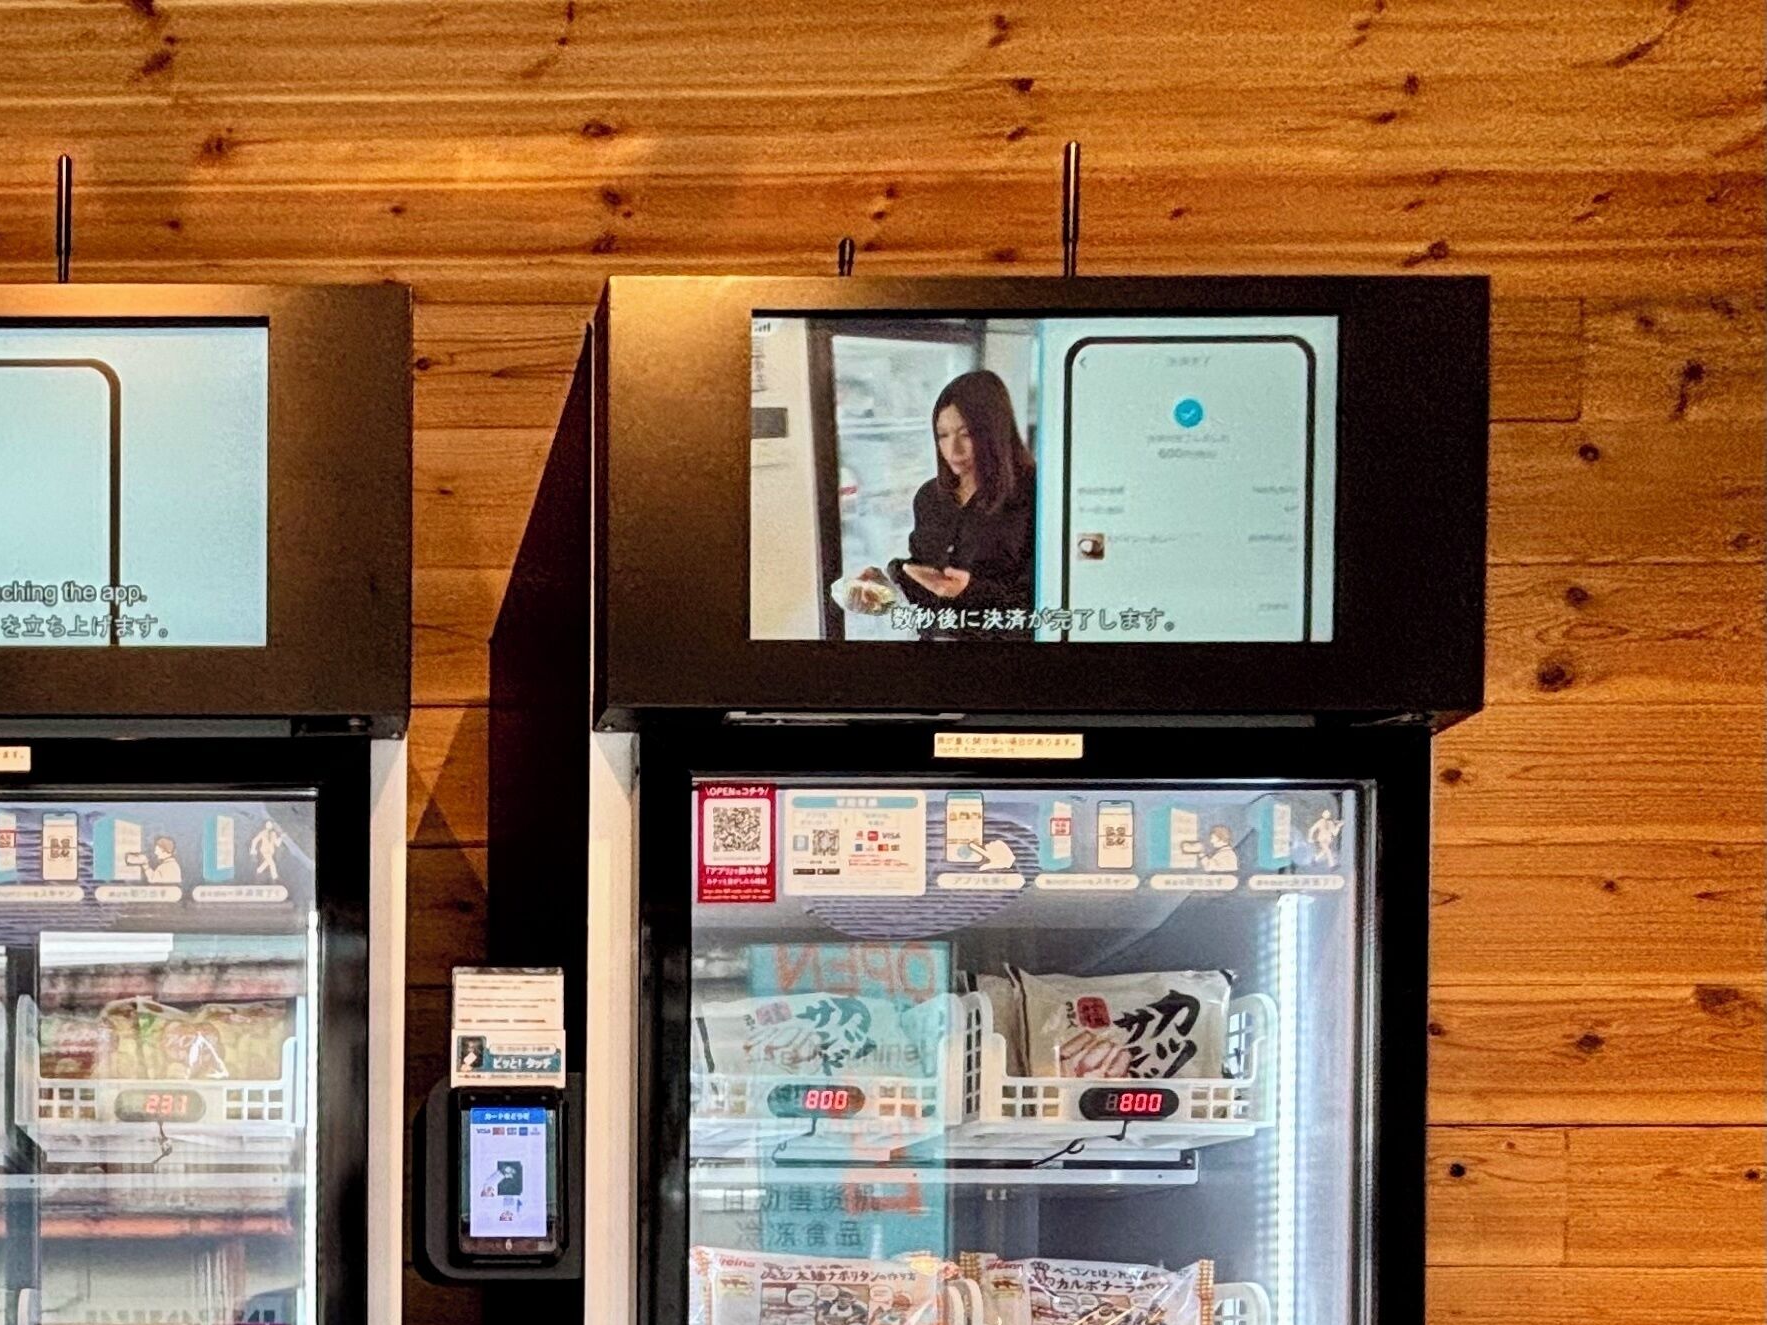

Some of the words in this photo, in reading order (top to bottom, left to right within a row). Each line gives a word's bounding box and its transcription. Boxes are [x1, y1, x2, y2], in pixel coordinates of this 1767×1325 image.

[62, 581, 96, 602] the
[100, 586, 147, 607] app.
[891, 607, 1177, 633] 数秒後に決済が完了します。
[525, 1056, 553, 1068] タッチ
[146, 1095, 188, 1113] 231
[806, 1091, 849, 1110] 800
[1119, 1093, 1162, 1112] 800
